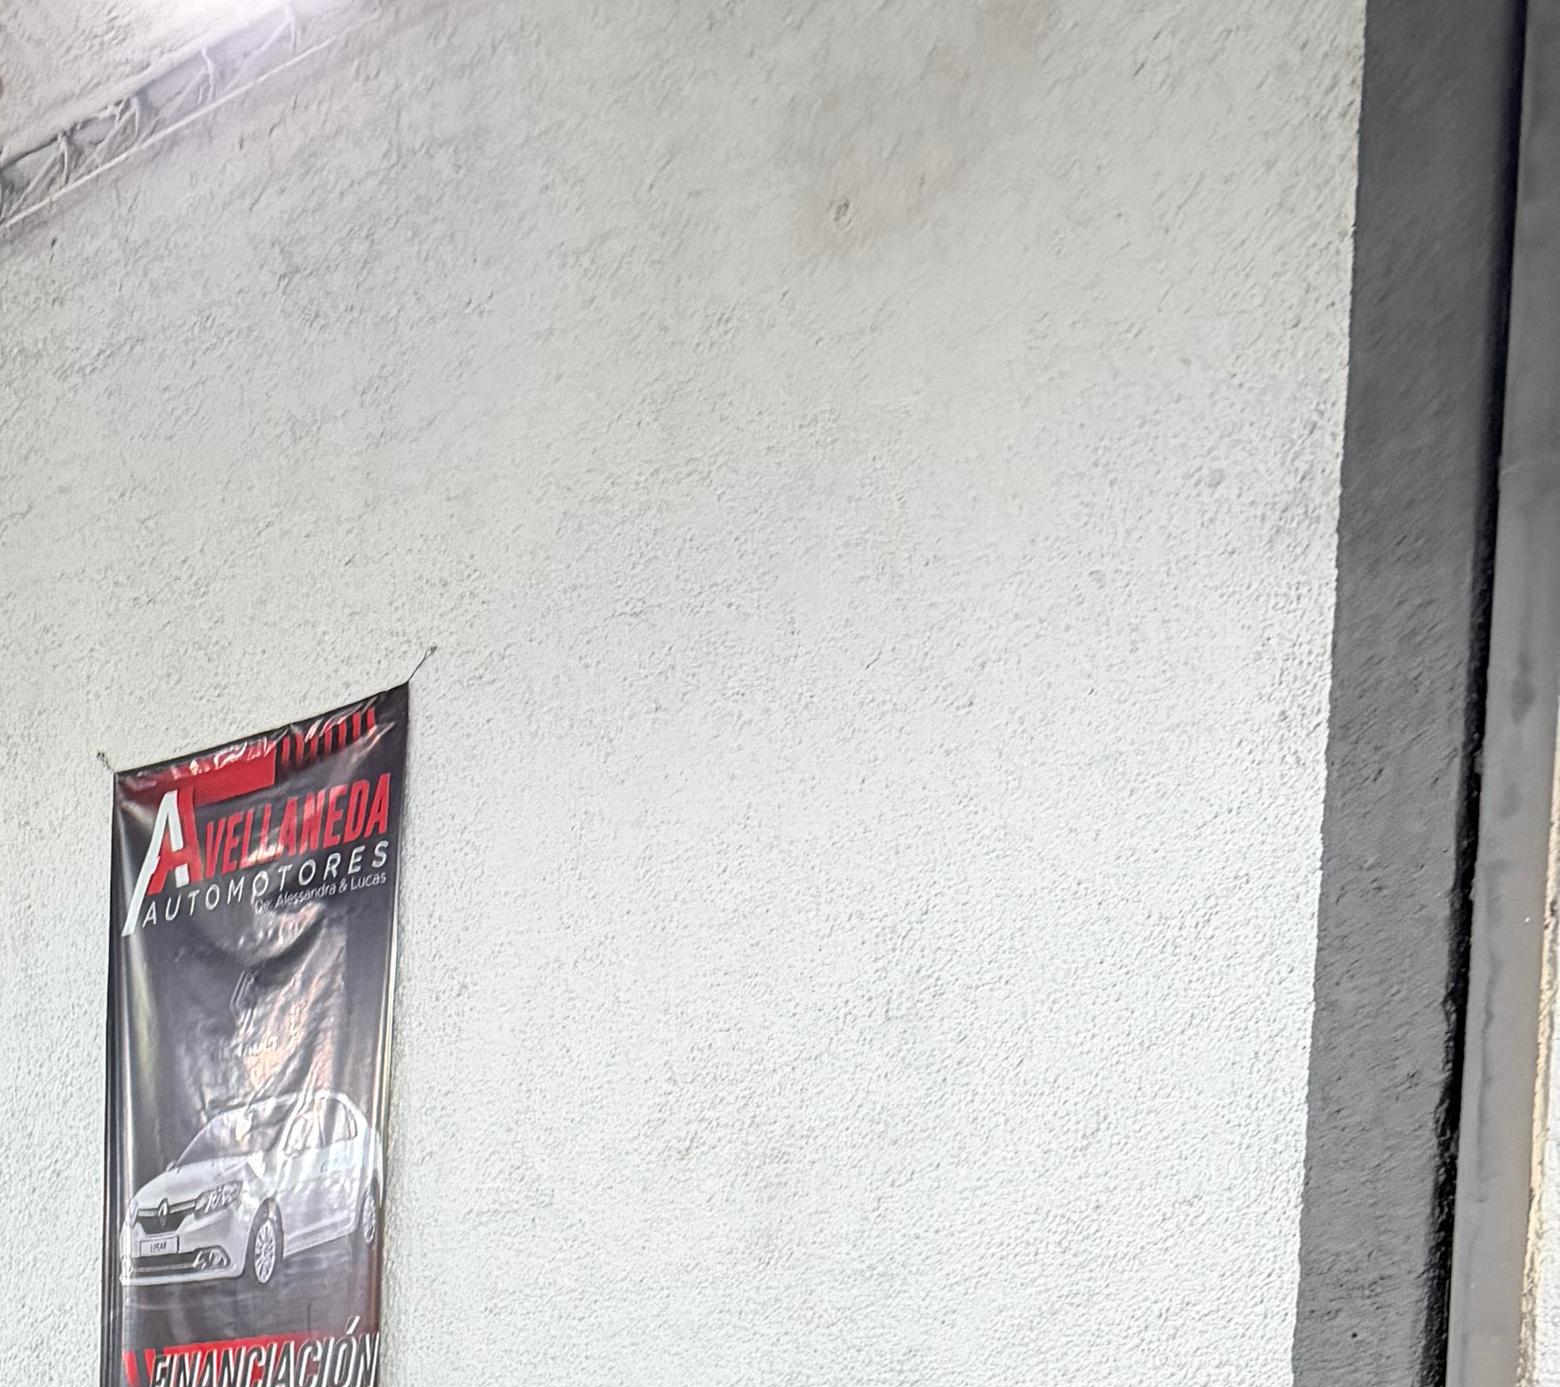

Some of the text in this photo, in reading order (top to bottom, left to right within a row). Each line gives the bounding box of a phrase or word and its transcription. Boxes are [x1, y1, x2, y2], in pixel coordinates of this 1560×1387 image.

[122, 773, 391, 938] AVELLANEDA
[142, 840, 390, 928] AUTOMOTORES
[338, 878, 348, 893] &
[350, 871, 387, 891] Lucas
